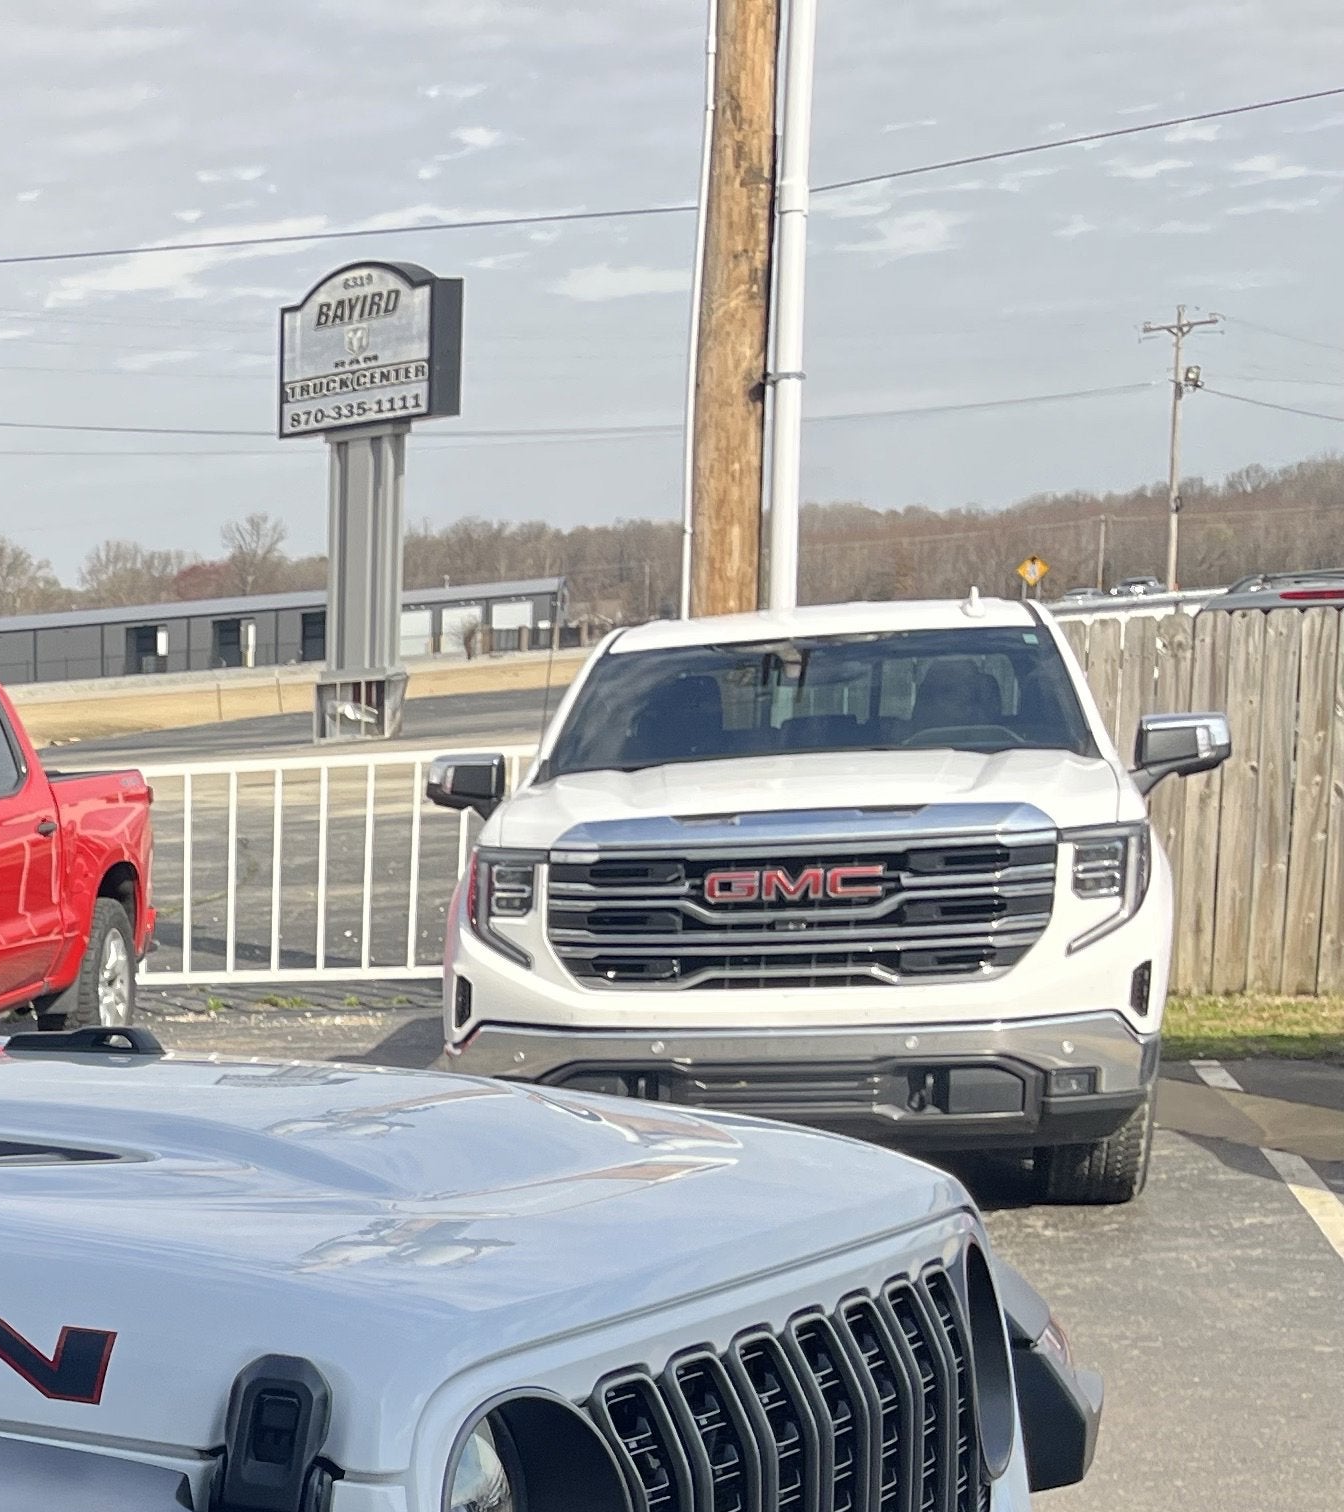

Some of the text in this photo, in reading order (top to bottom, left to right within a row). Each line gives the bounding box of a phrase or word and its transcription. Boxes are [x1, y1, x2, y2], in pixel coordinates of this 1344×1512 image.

[316, 289, 401, 327] BAYIRD
[334, 354, 379, 369] RAM
[288, 364, 426, 399] TRUCK CENTER
[290, 393, 422, 428] 870-335-1111
[705, 864, 886, 903] GMC
